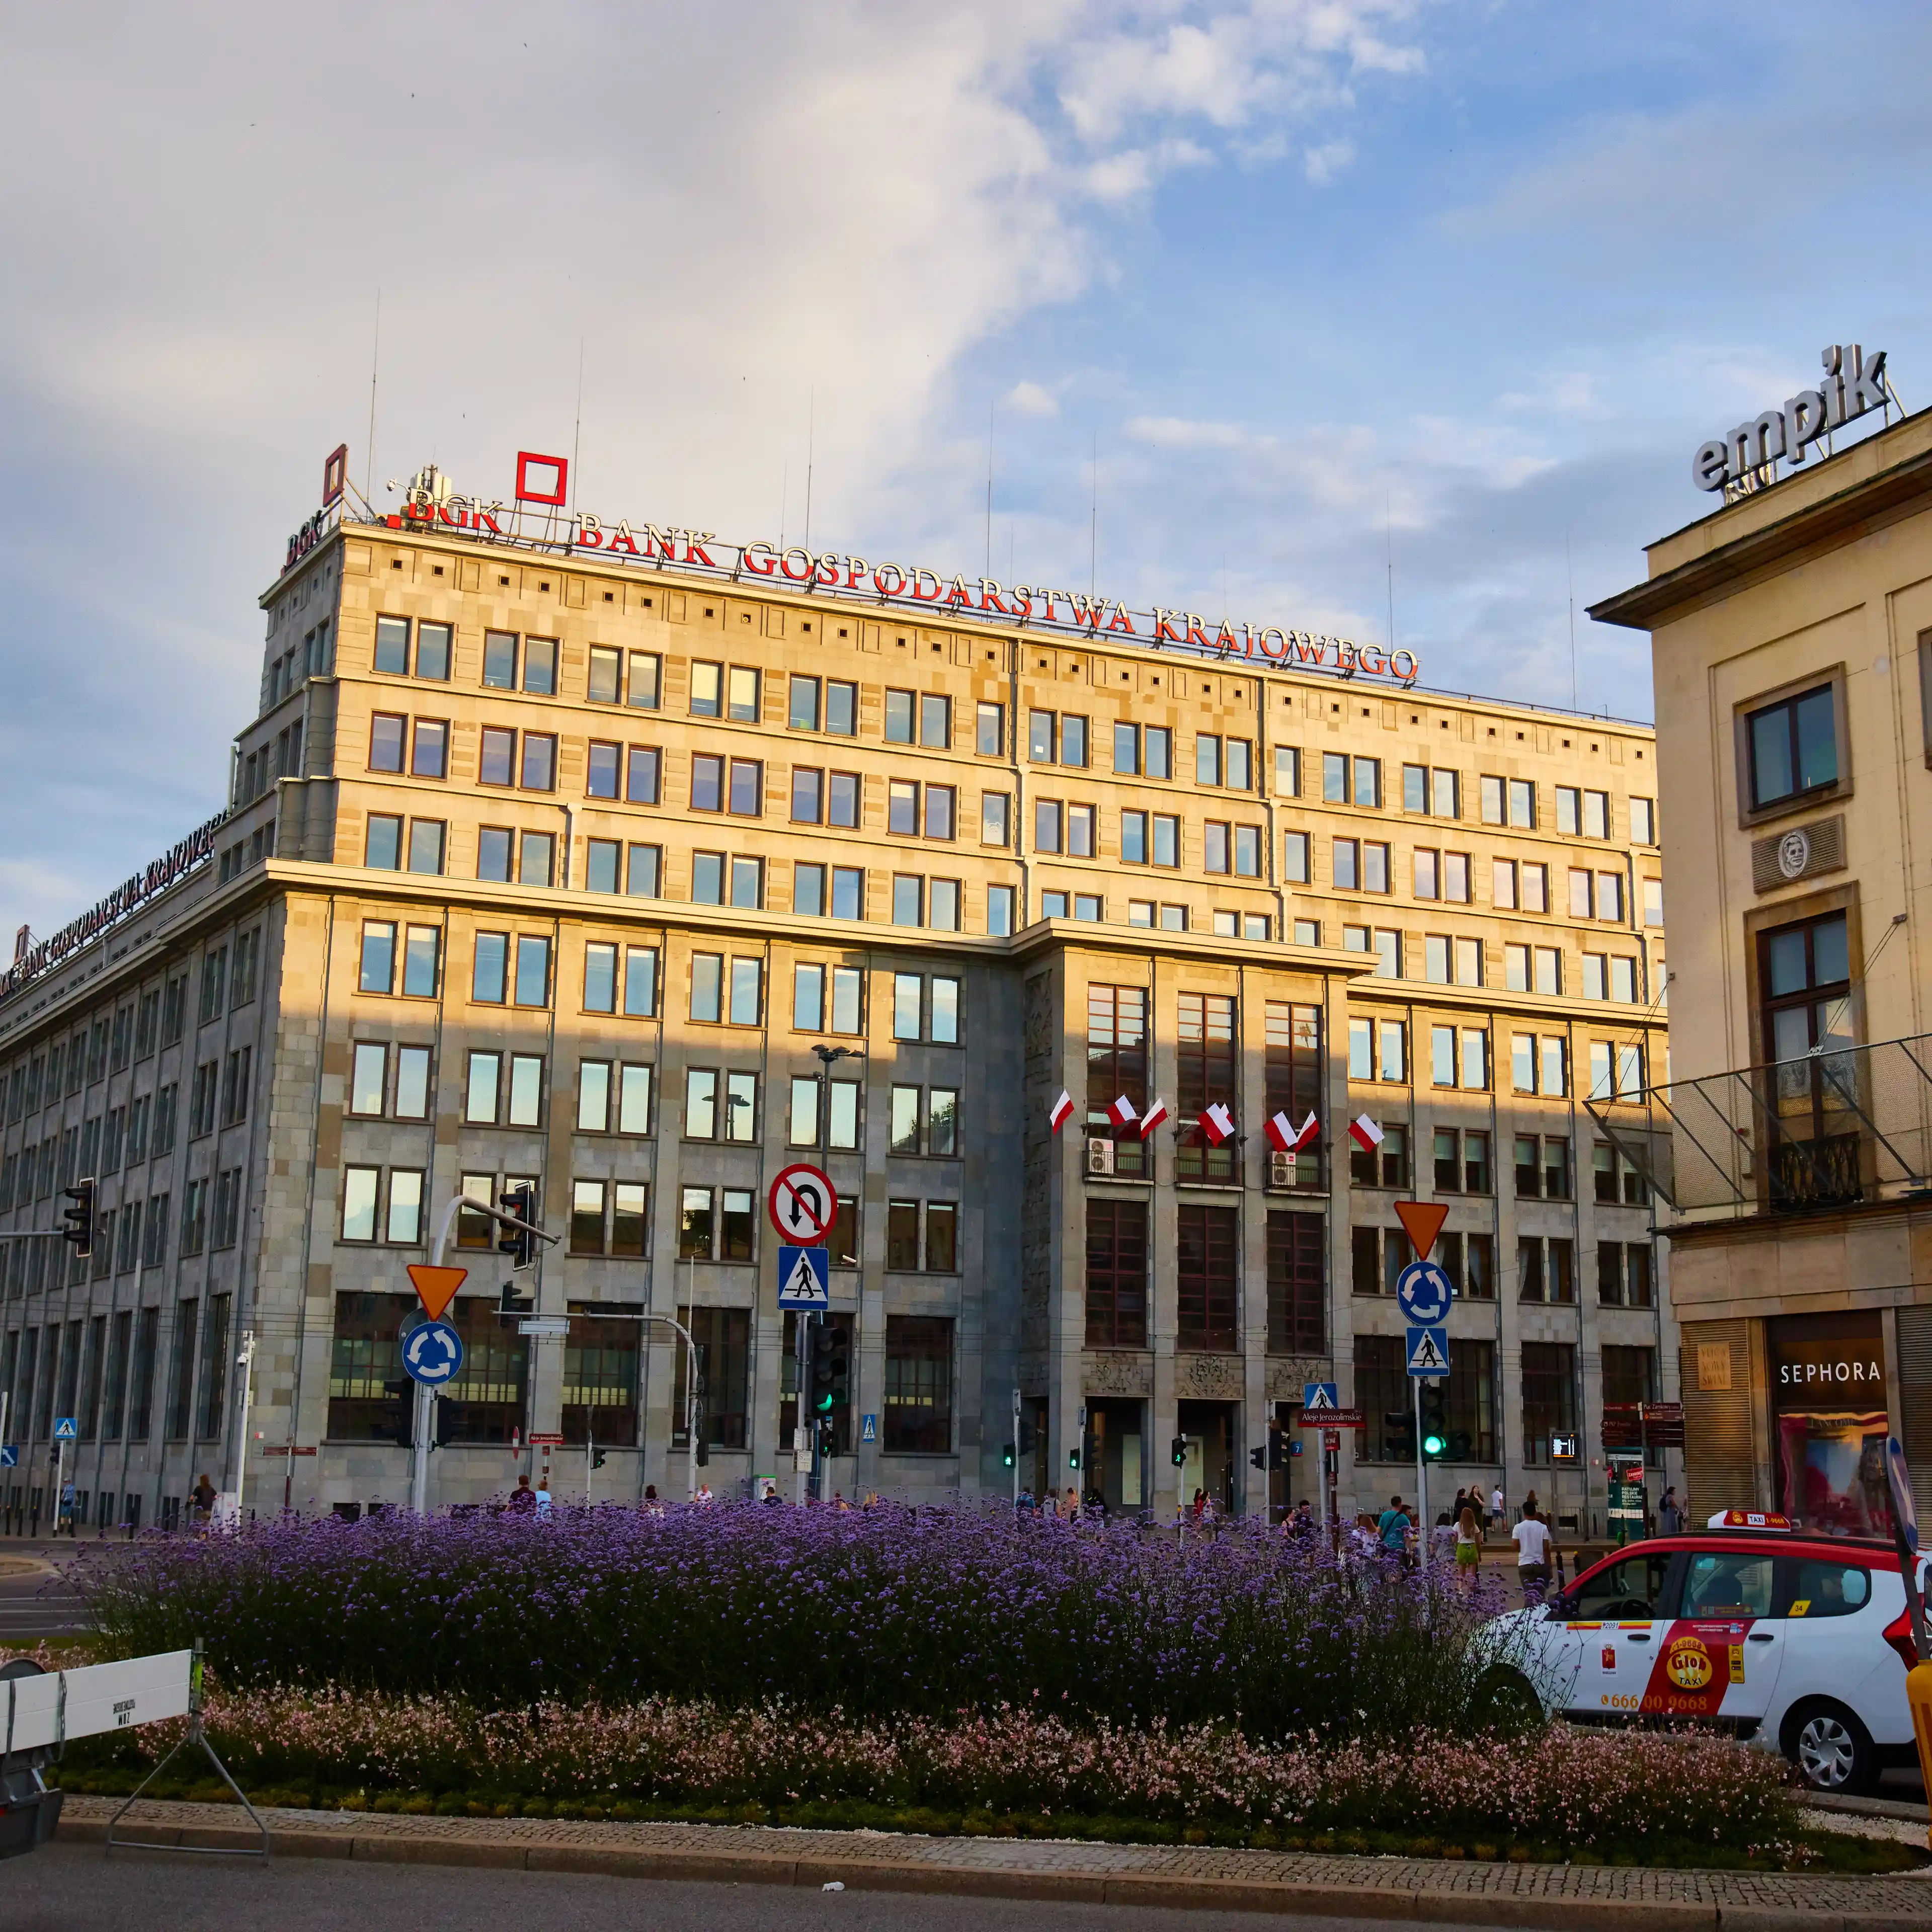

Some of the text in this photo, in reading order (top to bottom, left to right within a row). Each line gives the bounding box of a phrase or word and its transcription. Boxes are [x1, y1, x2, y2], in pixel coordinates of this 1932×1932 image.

[1693, 344, 1891, 492] empik
[408, 487, 503, 533] BGK
[286, 510, 324, 568] BGK
[575, 512, 1419, 679] BANK GOSPODARSTWA KRAJOWEGO
[20, 939, 51, 981] BANK
[51, 872, 140, 961] GOSPODARSTWA
[1781, 1361, 1881, 1384] SEPHORA
[1303, 1413, 1361, 1423] Aleje Jerozolimskie
[1671, 1654, 1707, 1670] Glob
[1679, 1677, 1703, 1685] TAXI
[1612, 1694, 1707, 1710] 666 00 9668
